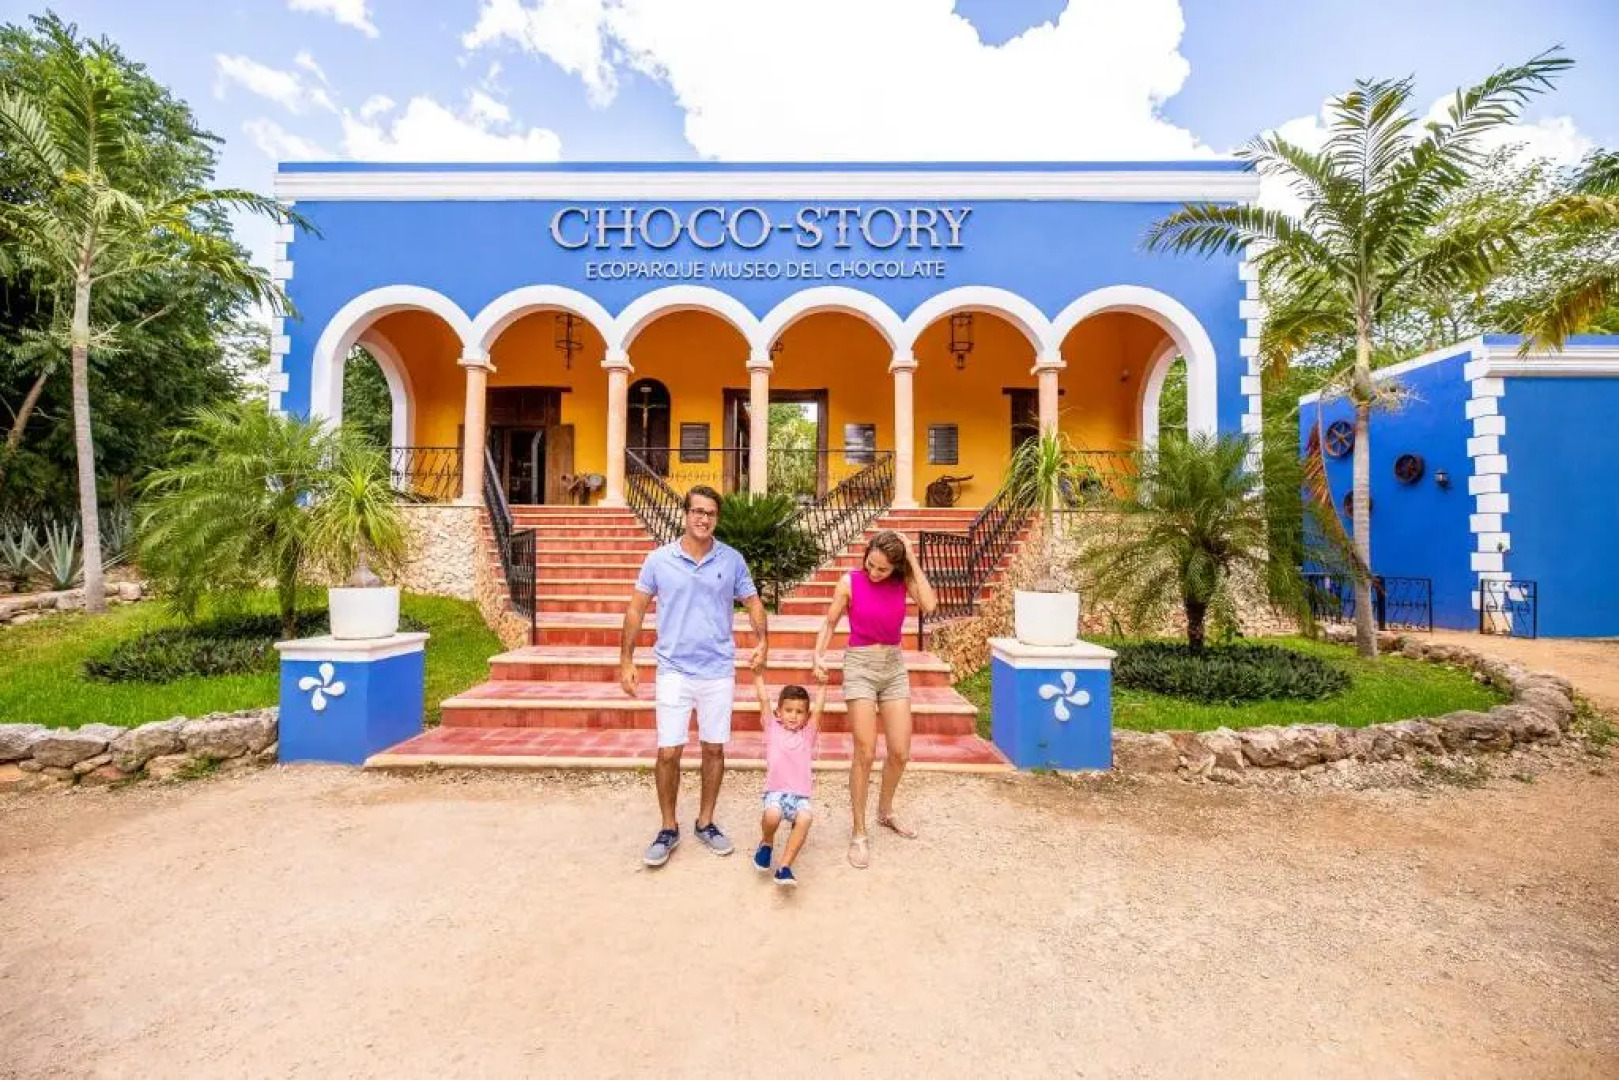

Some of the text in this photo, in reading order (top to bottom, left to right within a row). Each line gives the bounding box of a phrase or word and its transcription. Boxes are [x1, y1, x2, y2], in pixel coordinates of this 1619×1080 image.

[549, 206, 972, 249] CHOCO-STORY
[586, 261, 946, 280] ECOPARQUE MUSEO DEL CHOCOLATE
